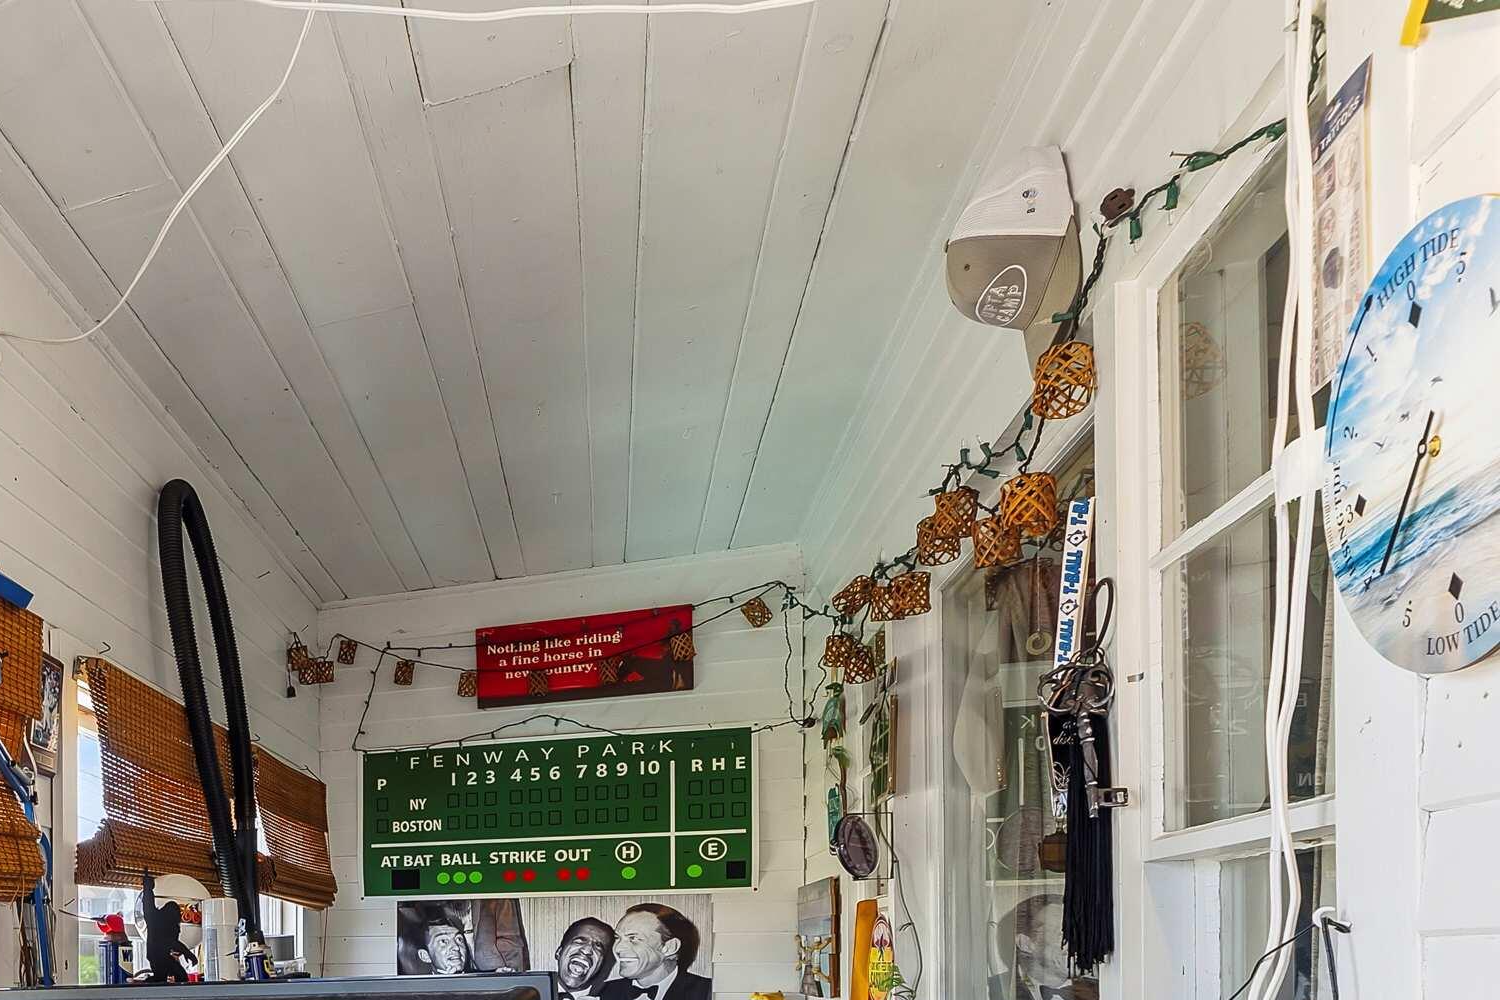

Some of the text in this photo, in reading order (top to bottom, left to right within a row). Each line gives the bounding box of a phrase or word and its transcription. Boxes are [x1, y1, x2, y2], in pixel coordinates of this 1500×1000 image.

[1377, 227, 1461, 310] HIGH TIDE
[1063, 550, 1083, 594] T-BALL
[1454, 601, 1465, 624] 0
[1426, 600, 1500, 655] LOW TIDE
[487, 631, 622, 656] Nothing like riding
[1057, 619, 1074, 665] T-BALL
[498, 645, 603, 668] a fine horse in
[409, 739, 674, 770] FENWAY PARK
[377, 756, 746, 792] P 1 2 3 4 5 6 7 8 9 10 R H E
[409, 798, 427, 811] NY
[392, 818, 442, 833] BOSTON
[380, 843, 718, 868] AT BAT BALL STRIKE OUT H E
